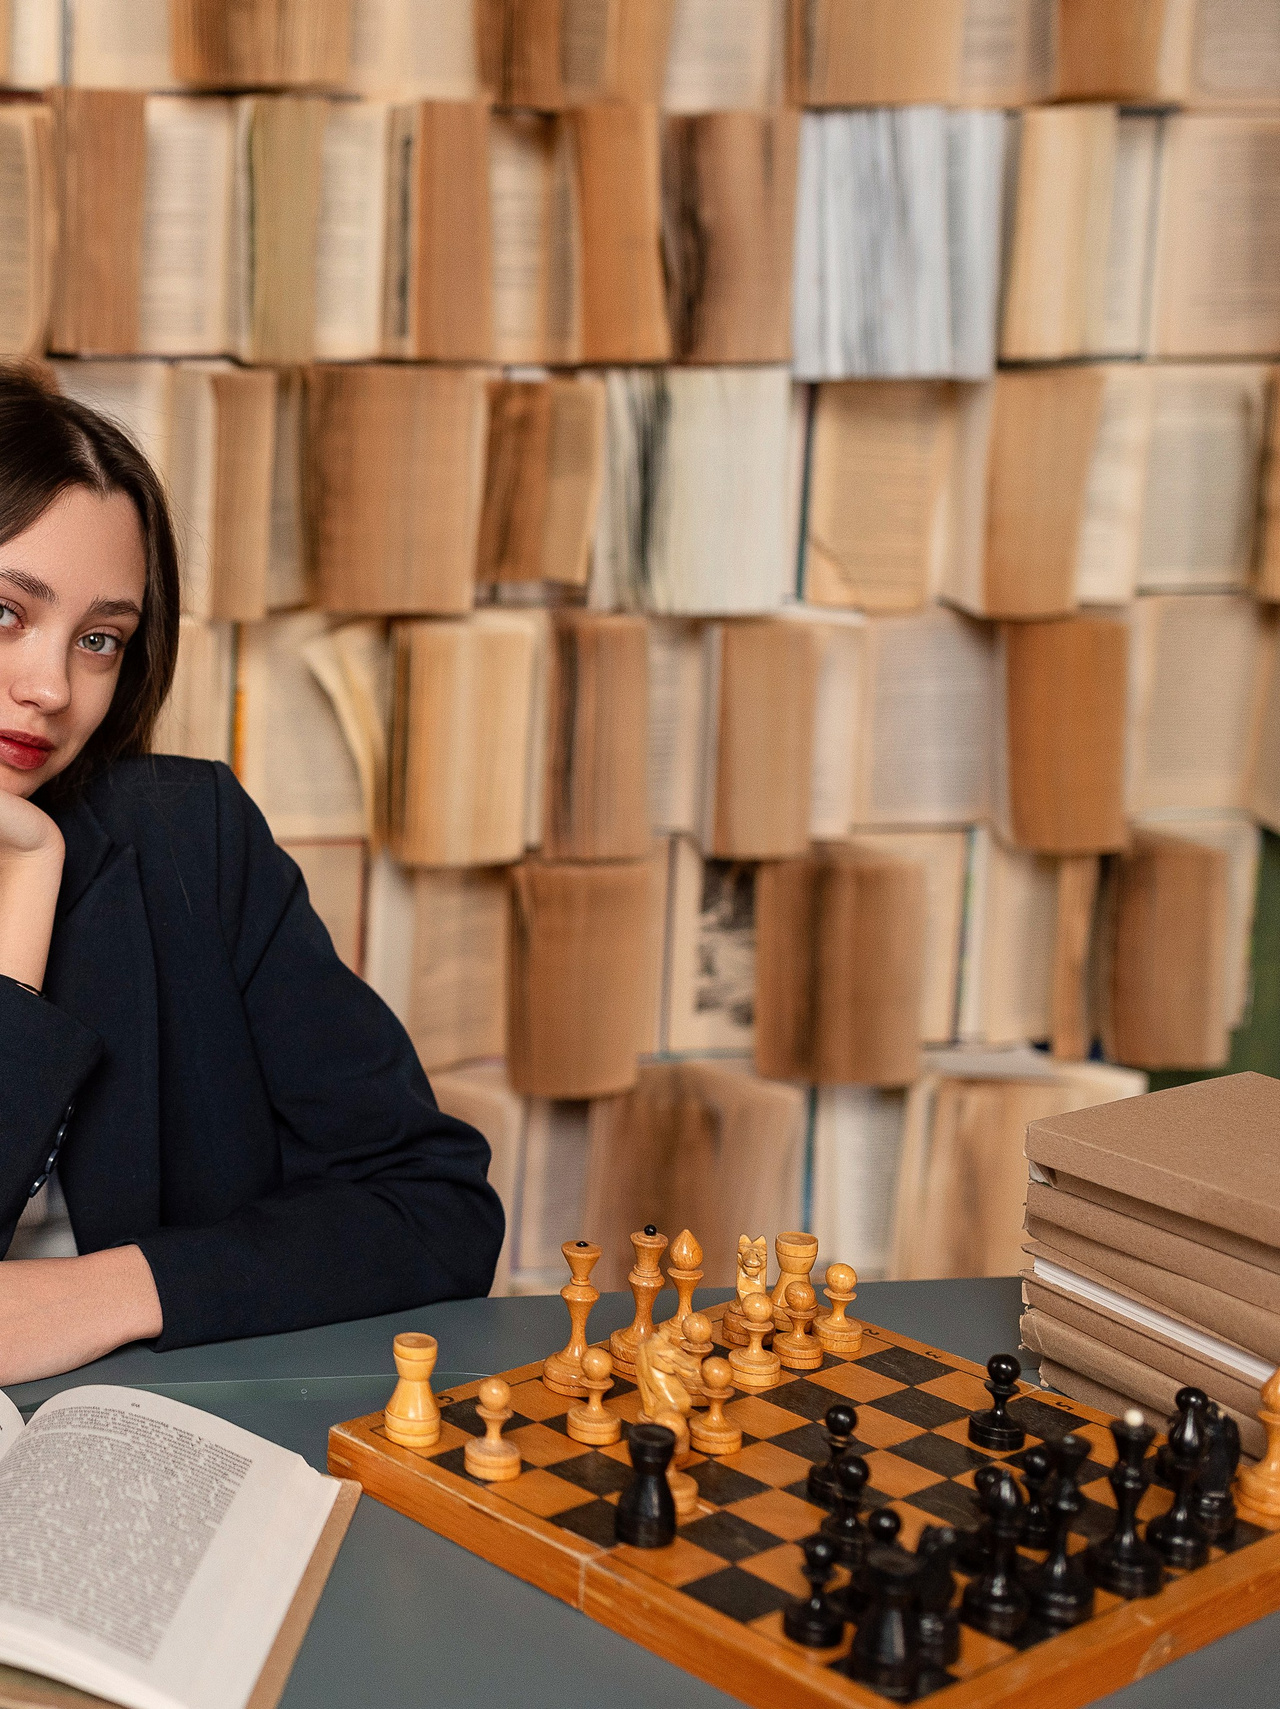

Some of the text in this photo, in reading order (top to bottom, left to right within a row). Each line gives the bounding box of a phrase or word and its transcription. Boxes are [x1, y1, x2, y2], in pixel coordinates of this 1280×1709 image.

[862, 1328, 880, 1336] 2
[925, 1350, 942, 1359] 3
[1054, 1401, 1075, 1411] 5
